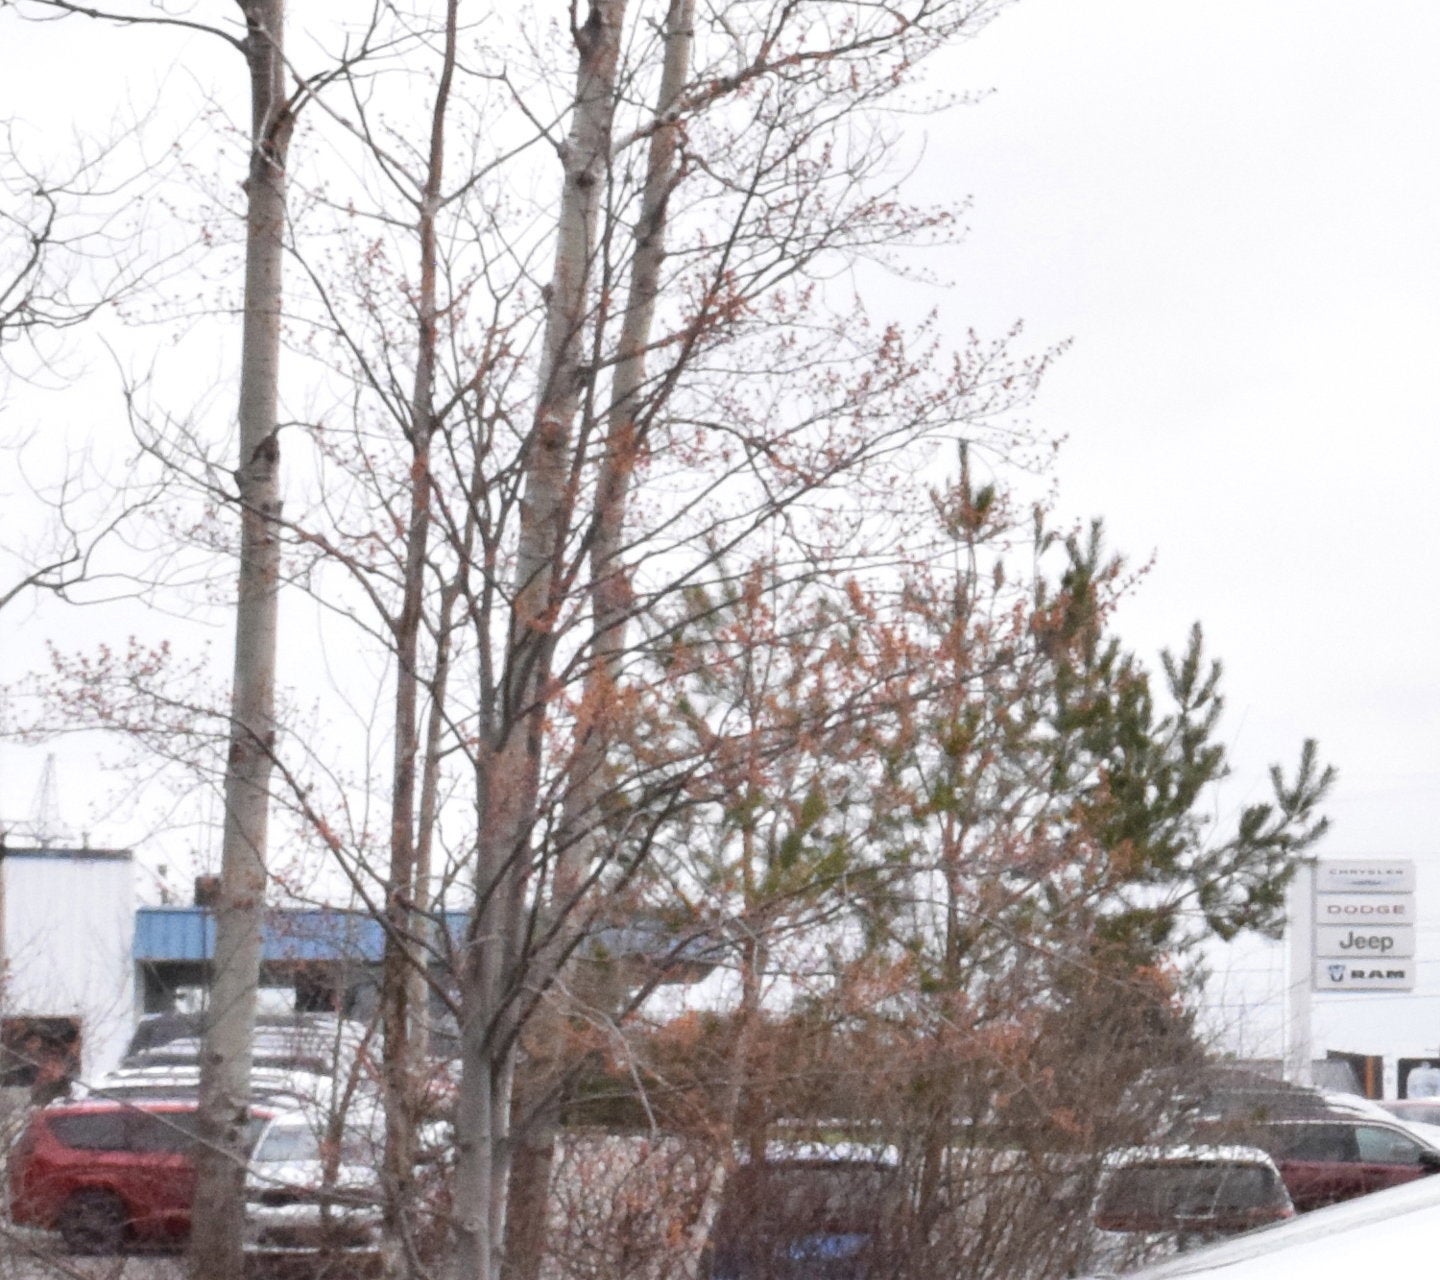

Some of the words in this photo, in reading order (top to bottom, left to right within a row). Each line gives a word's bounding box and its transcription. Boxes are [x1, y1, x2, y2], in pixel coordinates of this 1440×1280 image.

[1327, 905, 1405, 914] DODGE
[1339, 931, 1394, 952] Jeep
[1350, 970, 1405, 979] RAM
